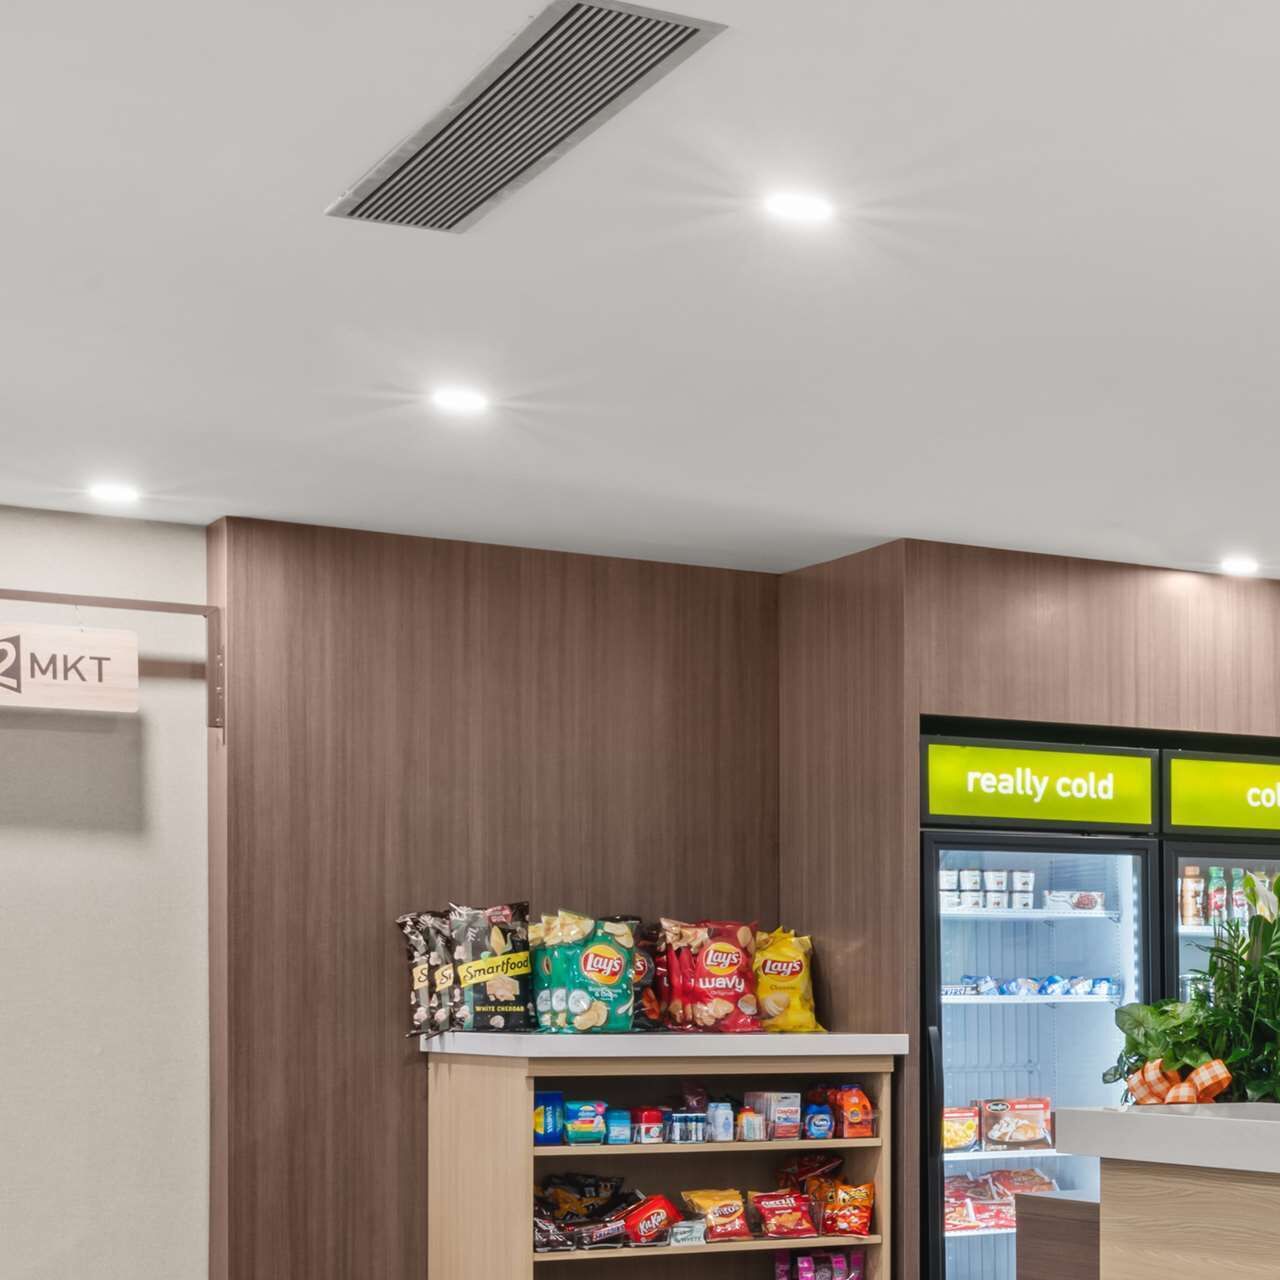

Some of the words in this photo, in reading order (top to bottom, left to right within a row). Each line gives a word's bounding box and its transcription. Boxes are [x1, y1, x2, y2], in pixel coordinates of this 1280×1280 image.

[29, 652, 111, 683] MKT
[966, 767, 1049, 802] really
[1056, 773, 1114, 800] cold
[463, 957, 529, 981] Smartfood
[699, 975, 745, 992] wavy
